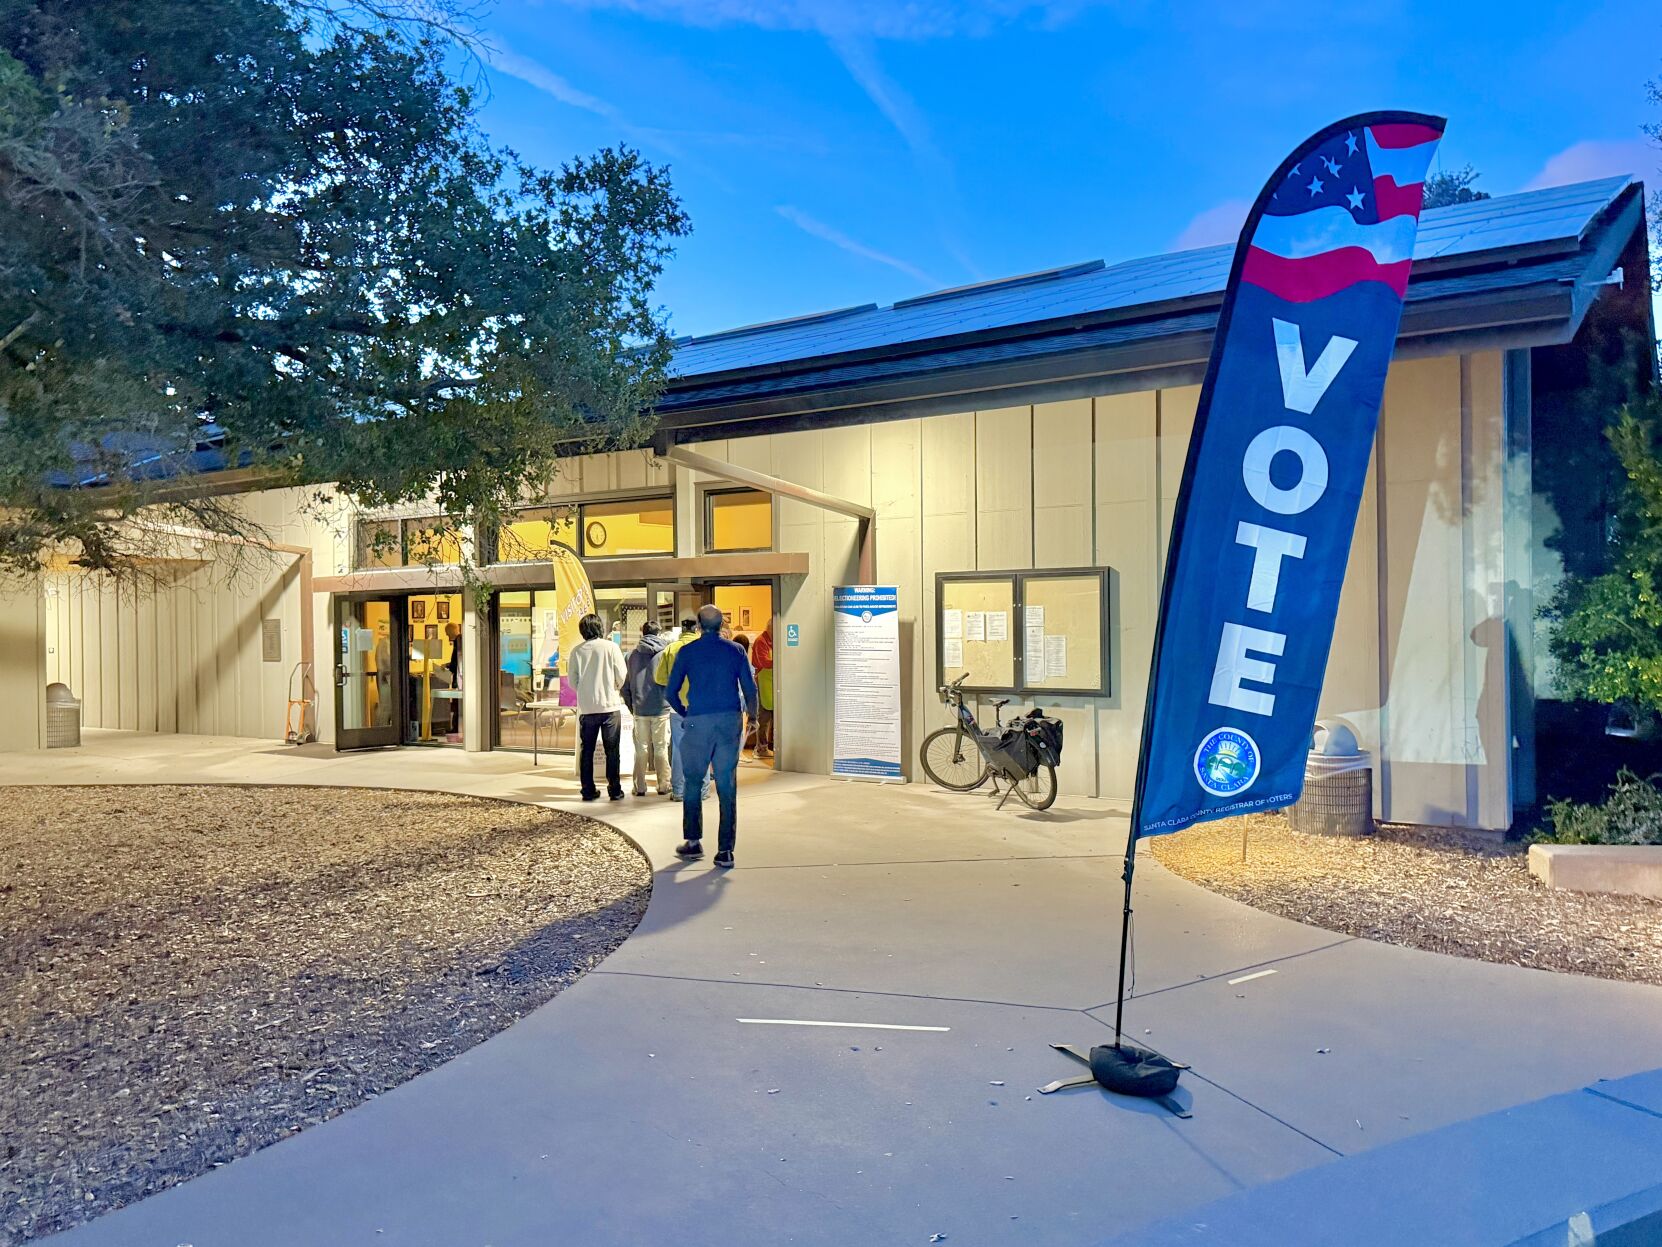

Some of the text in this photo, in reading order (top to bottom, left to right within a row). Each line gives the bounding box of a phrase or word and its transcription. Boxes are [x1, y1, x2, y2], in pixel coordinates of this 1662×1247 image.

[1208, 317, 1359, 717] VOTE
[1203, 733, 1255, 763] THE COUNTY OF
[1200, 767, 1249, 791] SANTA CLARA
[1143, 821, 1167, 831] SANTA
[1215, 800, 1254, 813] REGISTRAR
